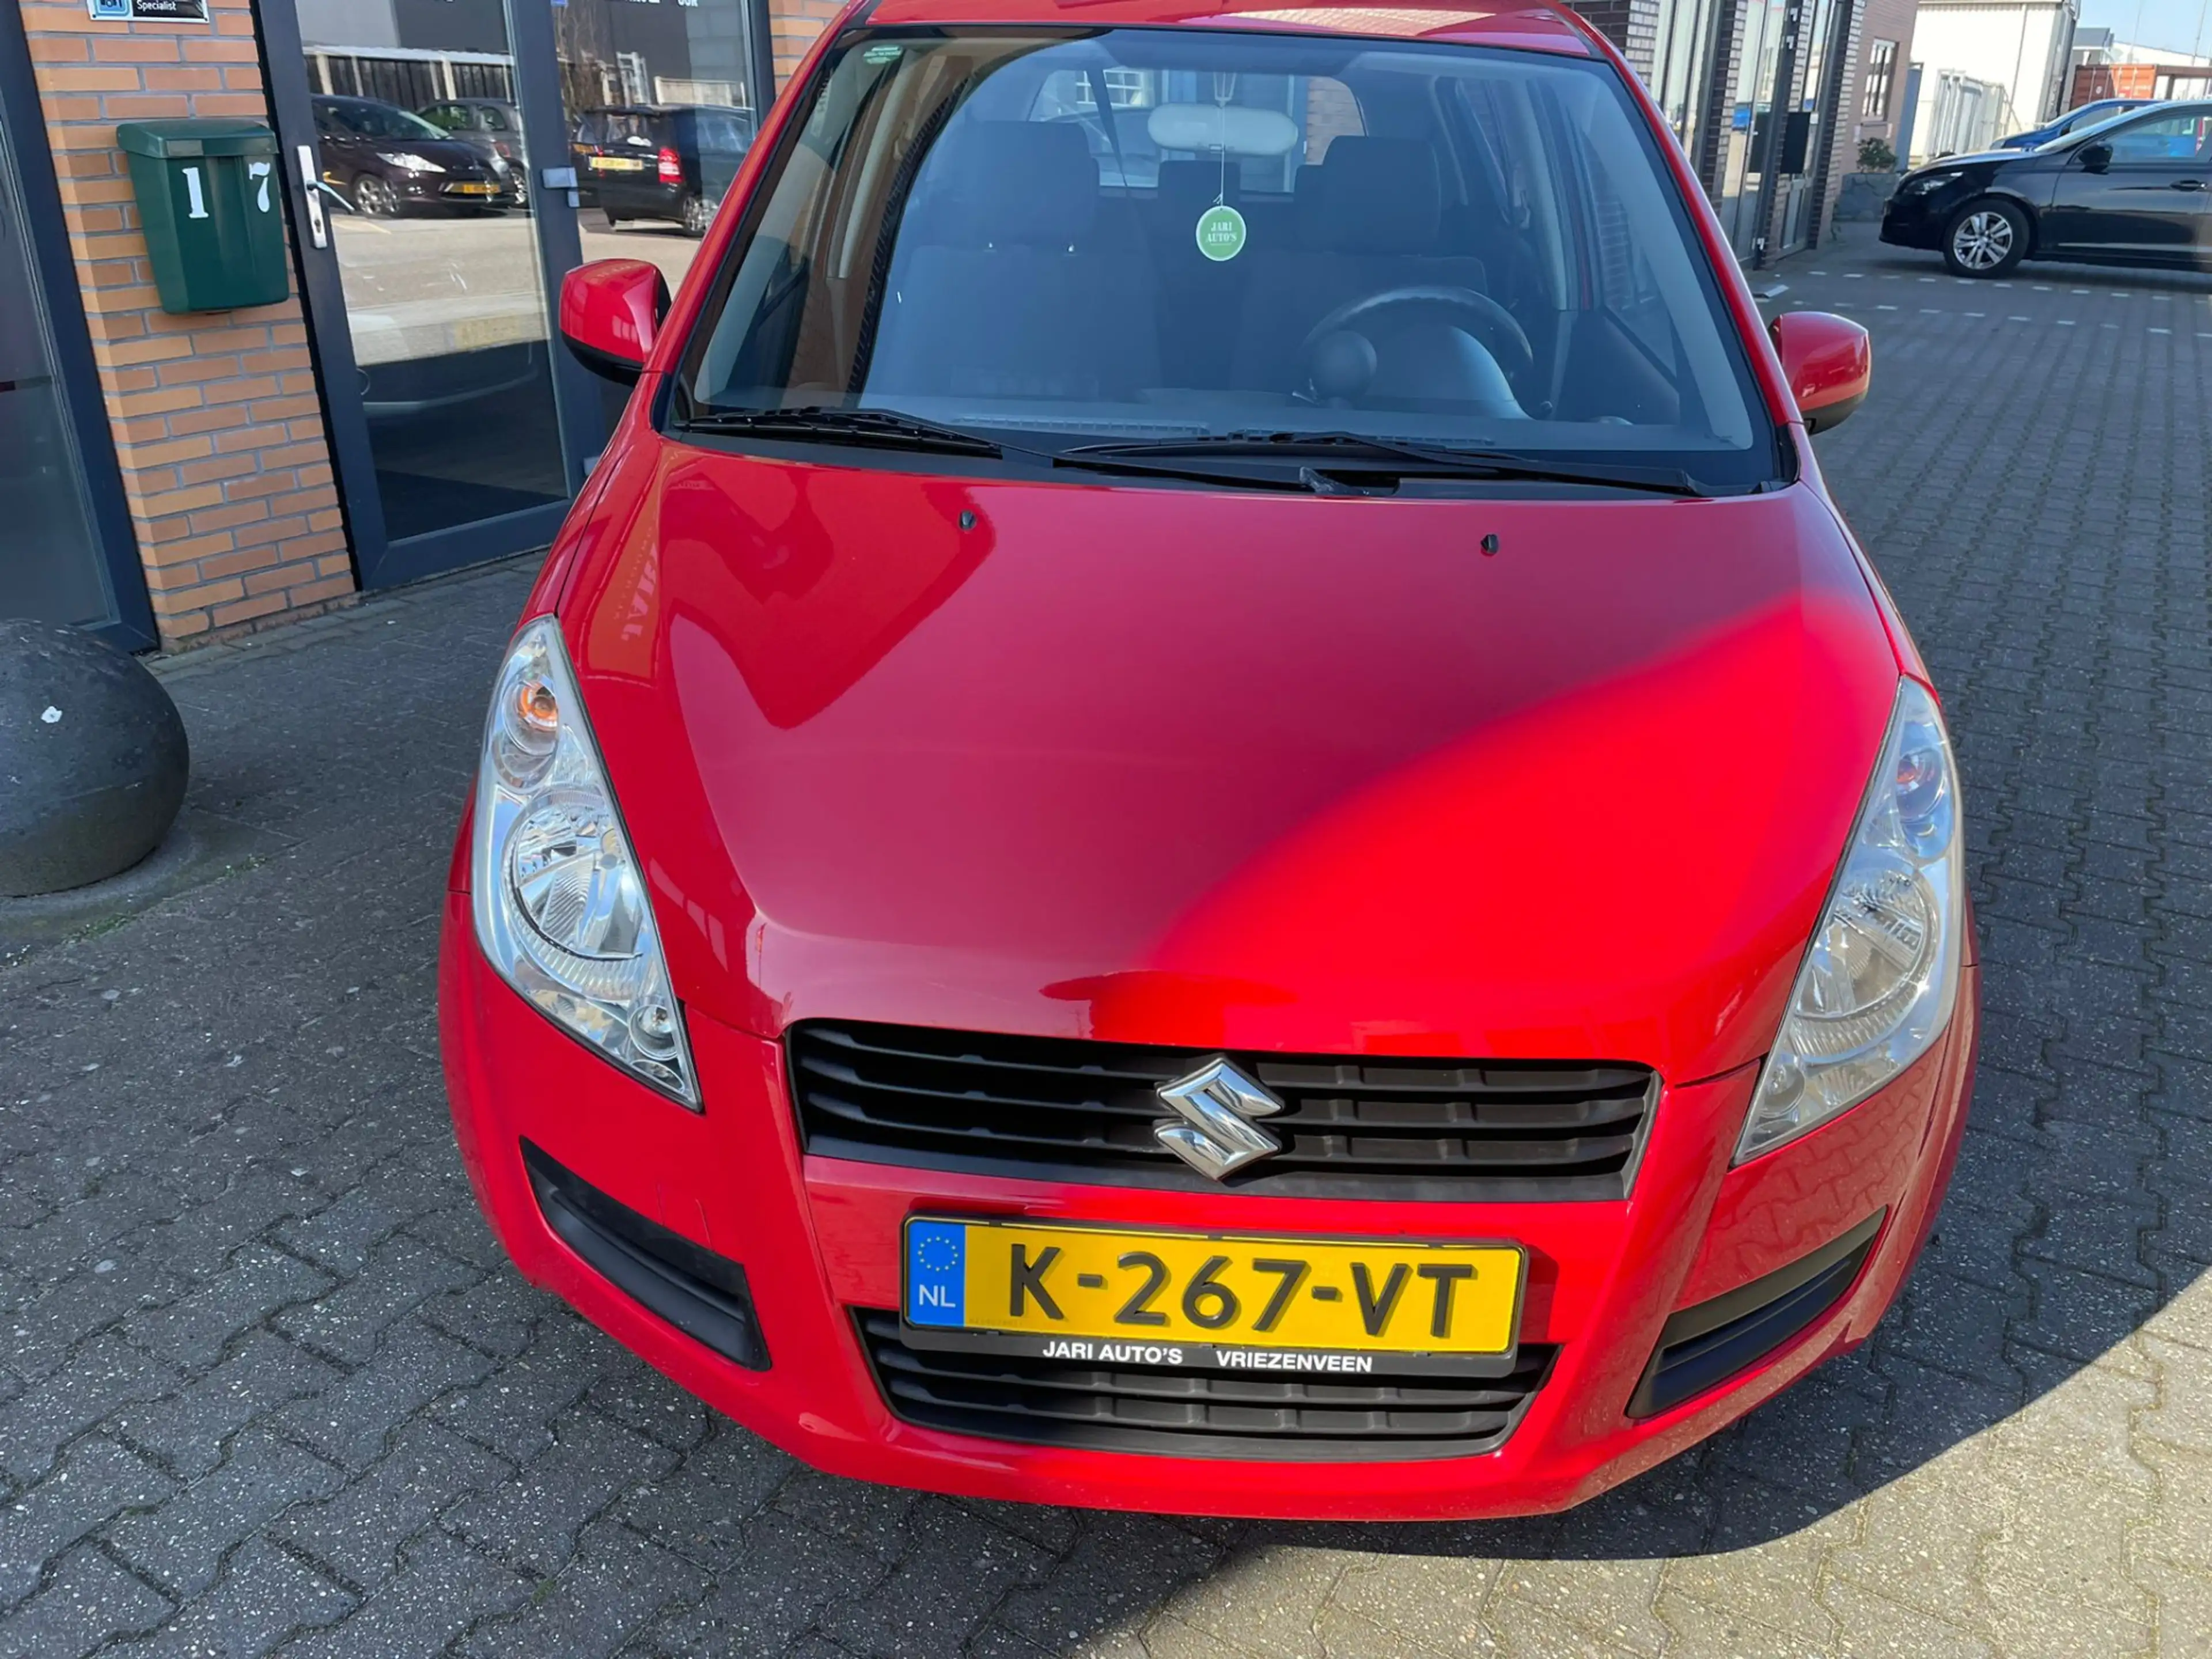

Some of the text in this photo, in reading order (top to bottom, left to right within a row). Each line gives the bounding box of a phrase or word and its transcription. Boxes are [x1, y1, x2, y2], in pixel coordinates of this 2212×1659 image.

[137, 0, 176, 12] Specialist
[1211, 222, 1232, 231] JARI
[1205, 232, 1237, 242] AUTO'S
[919, 1284, 956, 1308] NL
[1010, 1243, 1472, 1338] K-267-VT
[1043, 1342, 1373, 1372] JARI AUTO'S VRIEZENVEEN
